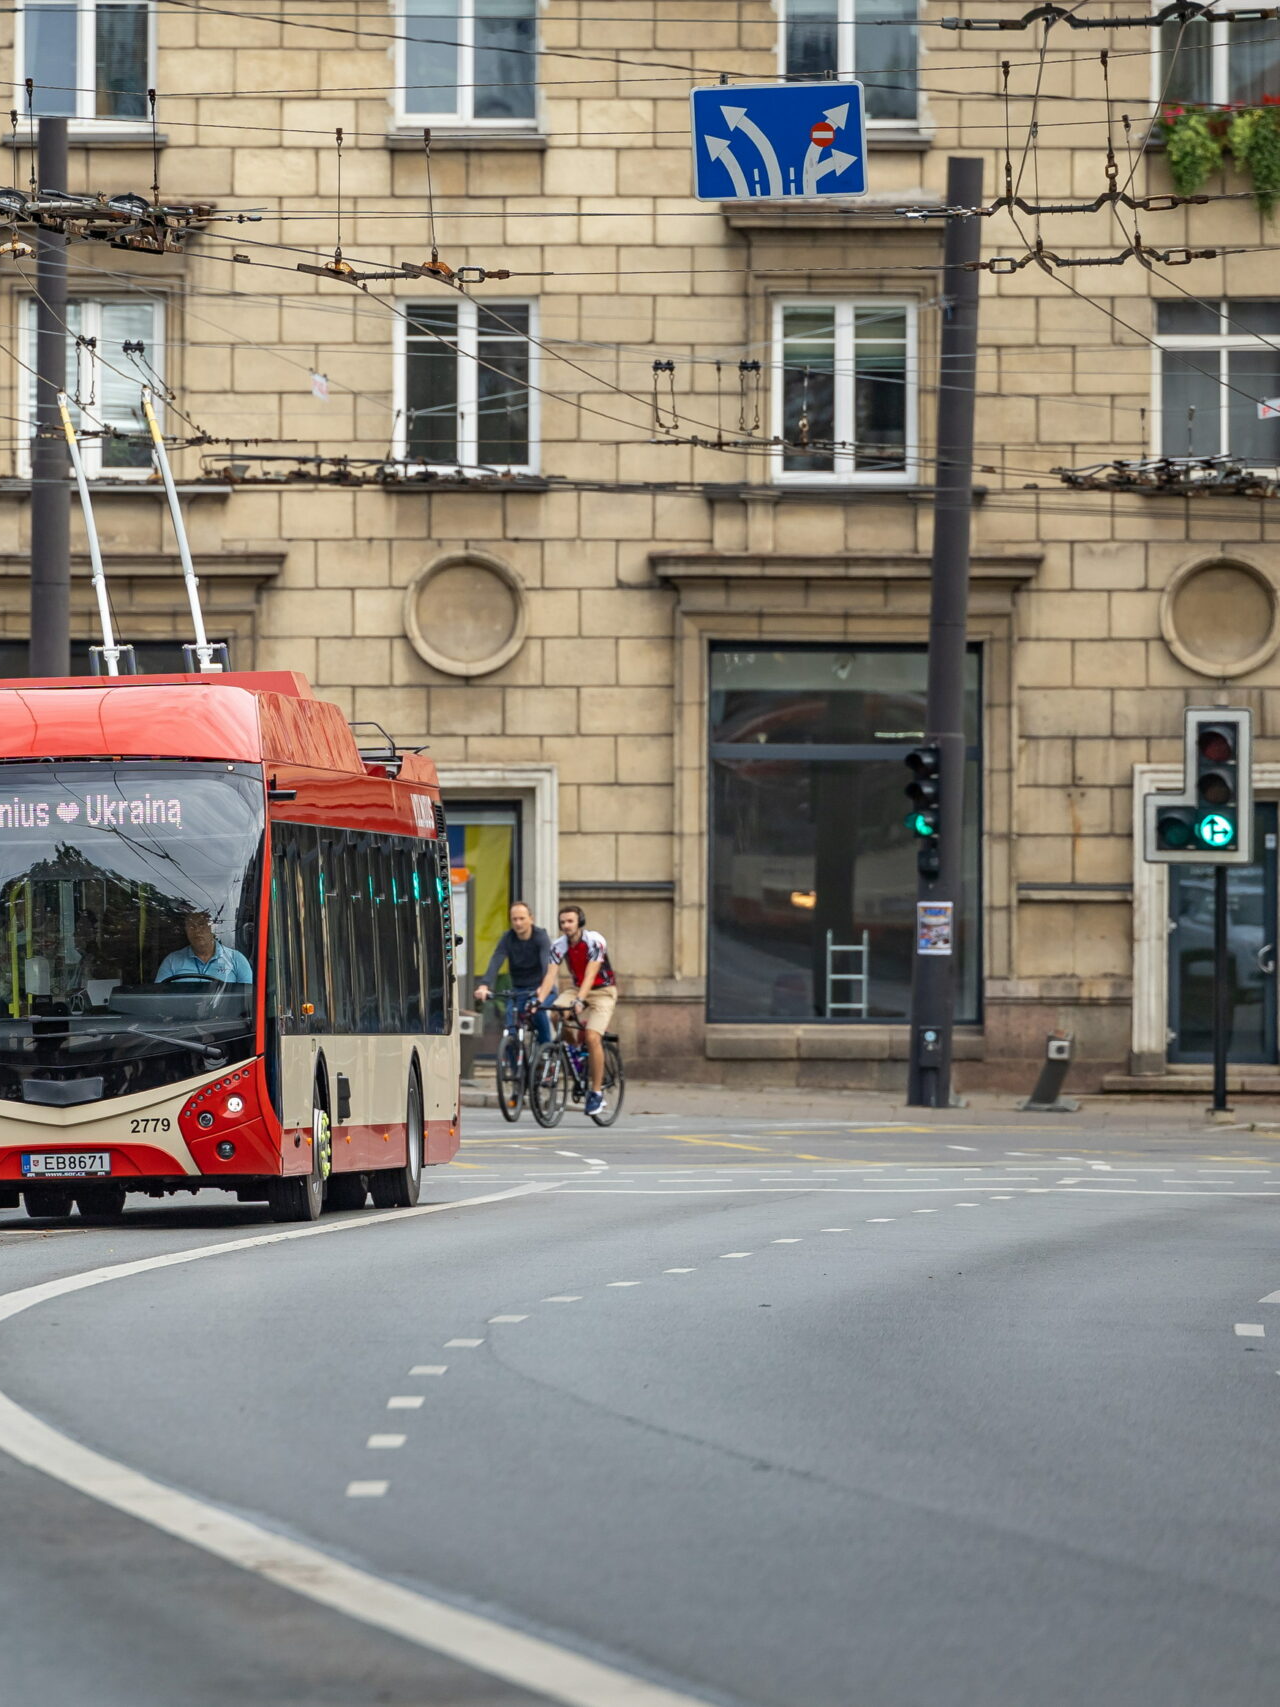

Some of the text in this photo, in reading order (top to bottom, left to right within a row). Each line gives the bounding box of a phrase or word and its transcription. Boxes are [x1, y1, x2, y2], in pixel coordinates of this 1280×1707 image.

[85, 793, 184, 830] Ukrainą
[130, 1117, 171, 1134] 2779
[44, 1155, 104, 1170] EB8671
